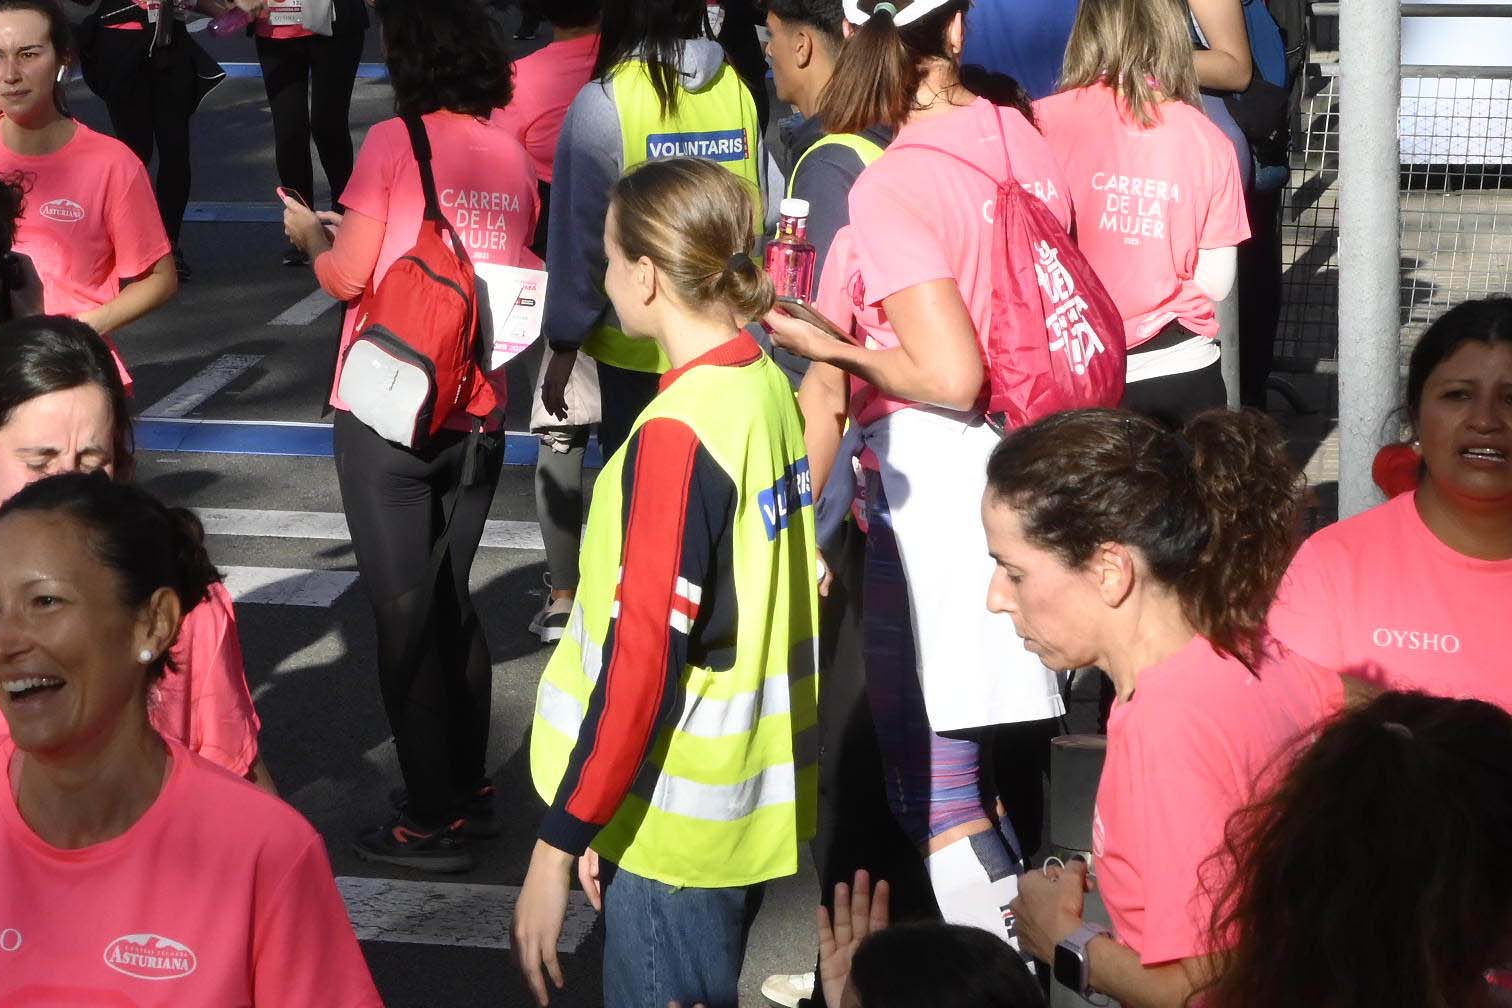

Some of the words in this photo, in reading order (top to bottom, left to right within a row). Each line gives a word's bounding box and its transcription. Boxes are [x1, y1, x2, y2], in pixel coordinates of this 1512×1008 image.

[440, 188, 520, 213] CARRERA
[1091, 172, 1180, 203] CARRERA
[1106, 193, 1130, 214] DE
[1138, 196, 1163, 218] LA
[456, 209, 480, 230] DE
[487, 212, 506, 231] LA
[1098, 213, 1165, 240] MUJER
[1372, 626, 1461, 654] OYSHO
[109, 944, 189, 971] ASTURIANA
